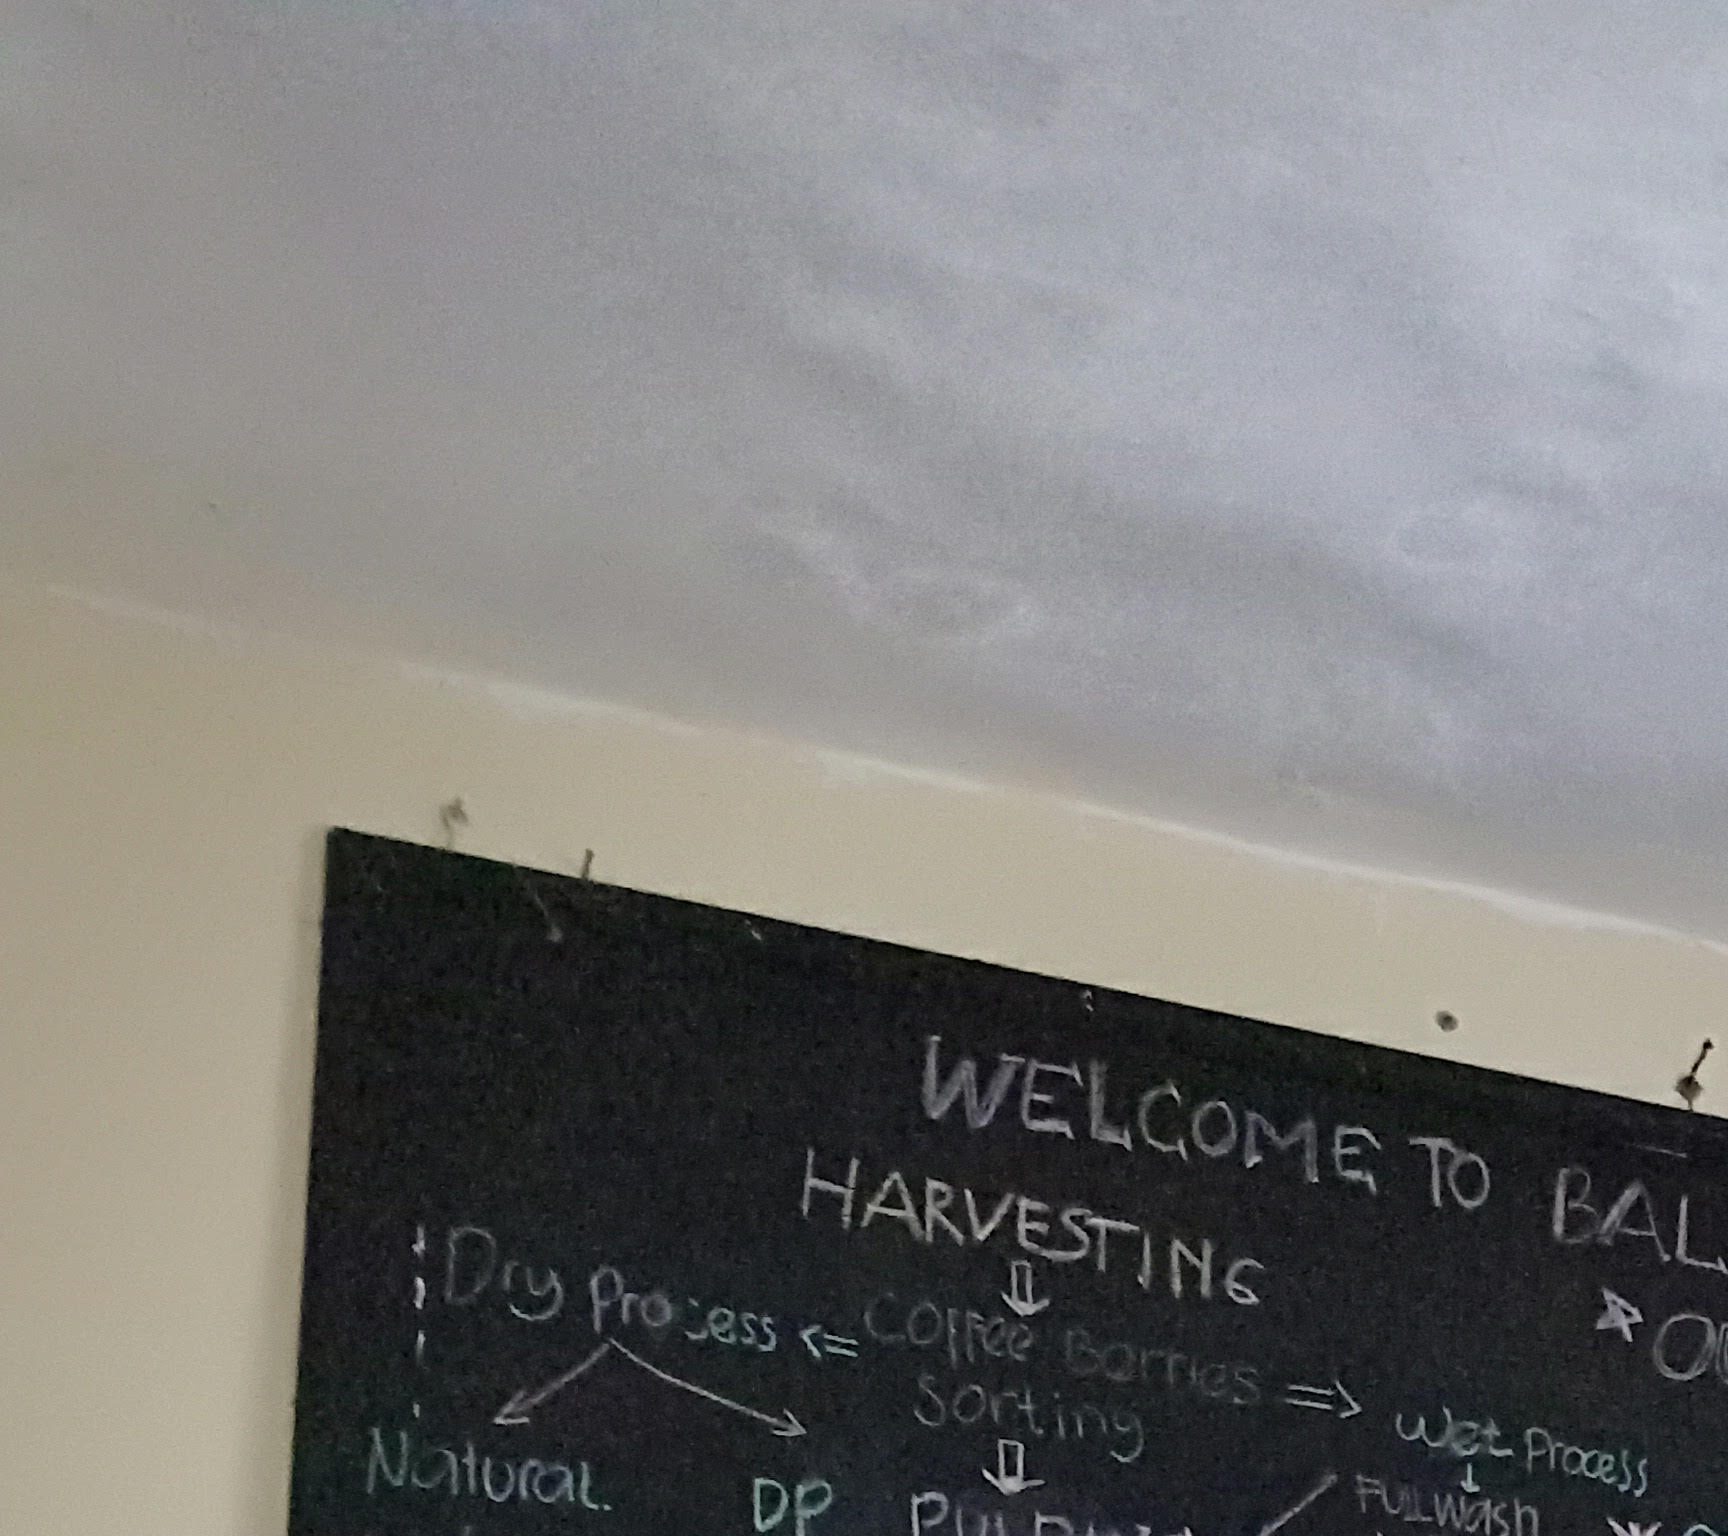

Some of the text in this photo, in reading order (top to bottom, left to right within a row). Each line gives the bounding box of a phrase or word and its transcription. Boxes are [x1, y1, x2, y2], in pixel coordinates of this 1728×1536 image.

[920, 1034, 1382, 1195] WELCOME
[1408, 1136, 1492, 1208] TO
[444, 1224, 566, 1322] Dry
[800, 1147, 1264, 1305] HARVESTING
[863, 1294, 1034, 1366] Coffee
[912, 1372, 1146, 1464] Sorting
[364, 1425, 614, 1513] Natural
